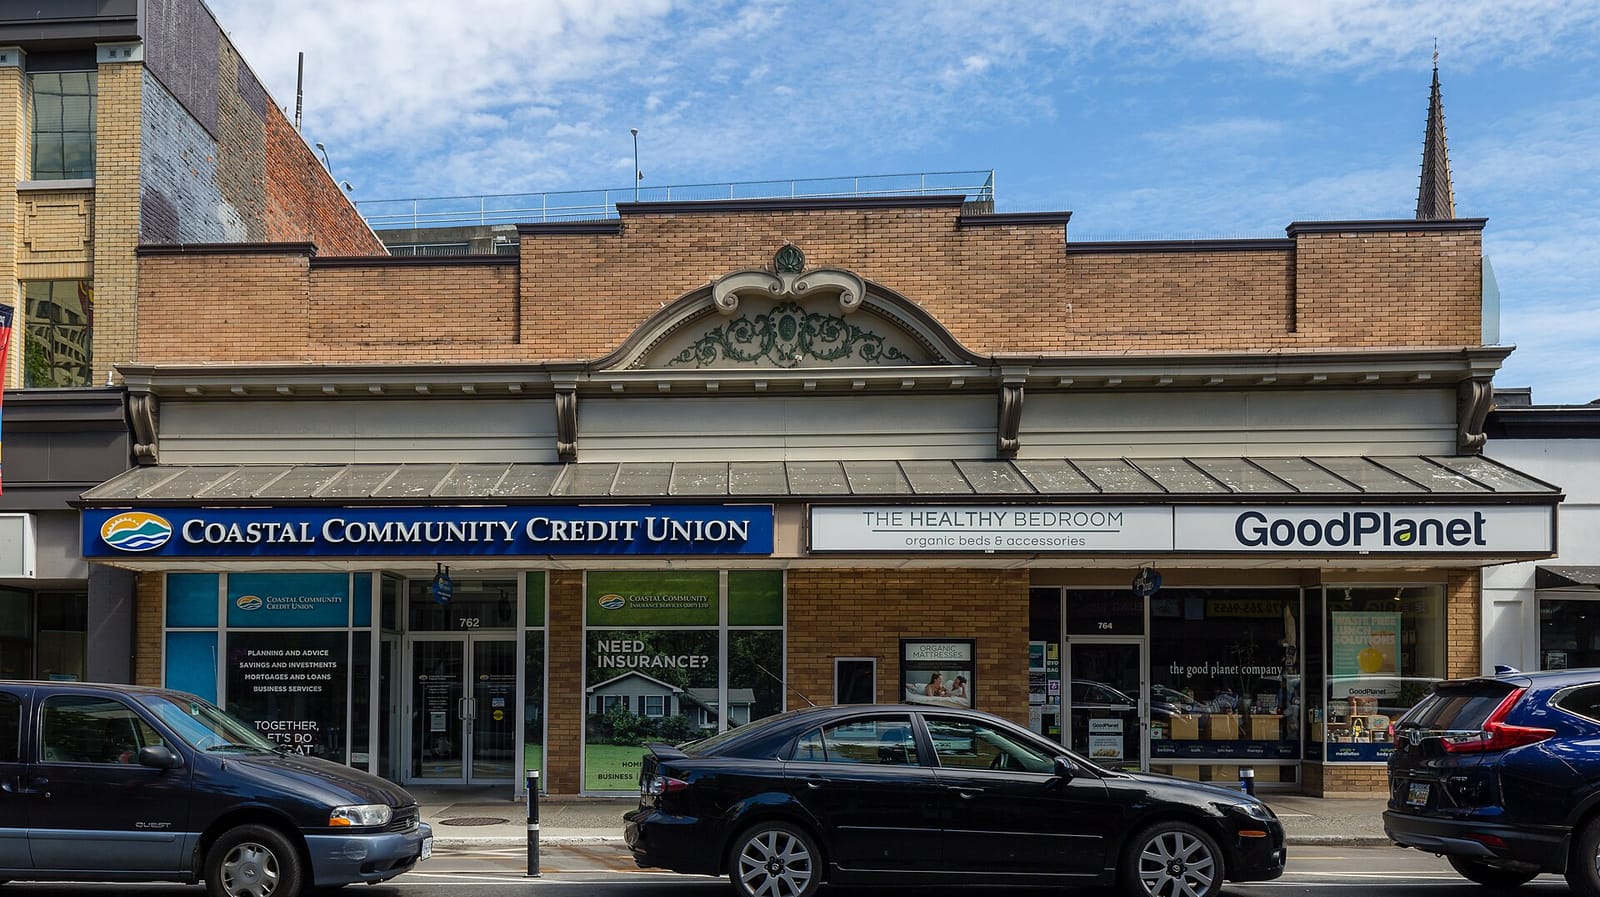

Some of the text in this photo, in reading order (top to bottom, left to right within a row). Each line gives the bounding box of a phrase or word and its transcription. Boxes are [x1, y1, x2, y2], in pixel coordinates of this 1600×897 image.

[863, 511, 1124, 527] THE HEALTHY BEDROOM
[182, 515, 751, 544] COASTAL COMMUNITY CREDIT UNION
[1235, 511, 1487, 547] GoodPlanet
[905, 535, 1086, 548] organic beds & accessories
[299, 595, 343, 603] COMMUNITY
[459, 618, 480, 628] 762
[1097, 621, 1113, 630] 764
[1371, 616, 1397, 625] FREE
[597, 639, 645, 653] NEED
[247, 649, 329, 657] PLANNING AND ADVICE
[239, 661, 337, 669] SAVINGS AND INVESTMENTS
[597, 655, 710, 668] INSURANCE?
[1169, 660, 1283, 679] the good planet company
[244, 673, 332, 681] MORTGAGES AND LOANS
[253, 685, 323, 693] BUSINESS SERVICES
[1348, 688, 1386, 696] GoodPlanet
[254, 720, 320, 732] TOGETHER,
[267, 733, 313, 743] ET'S DO
